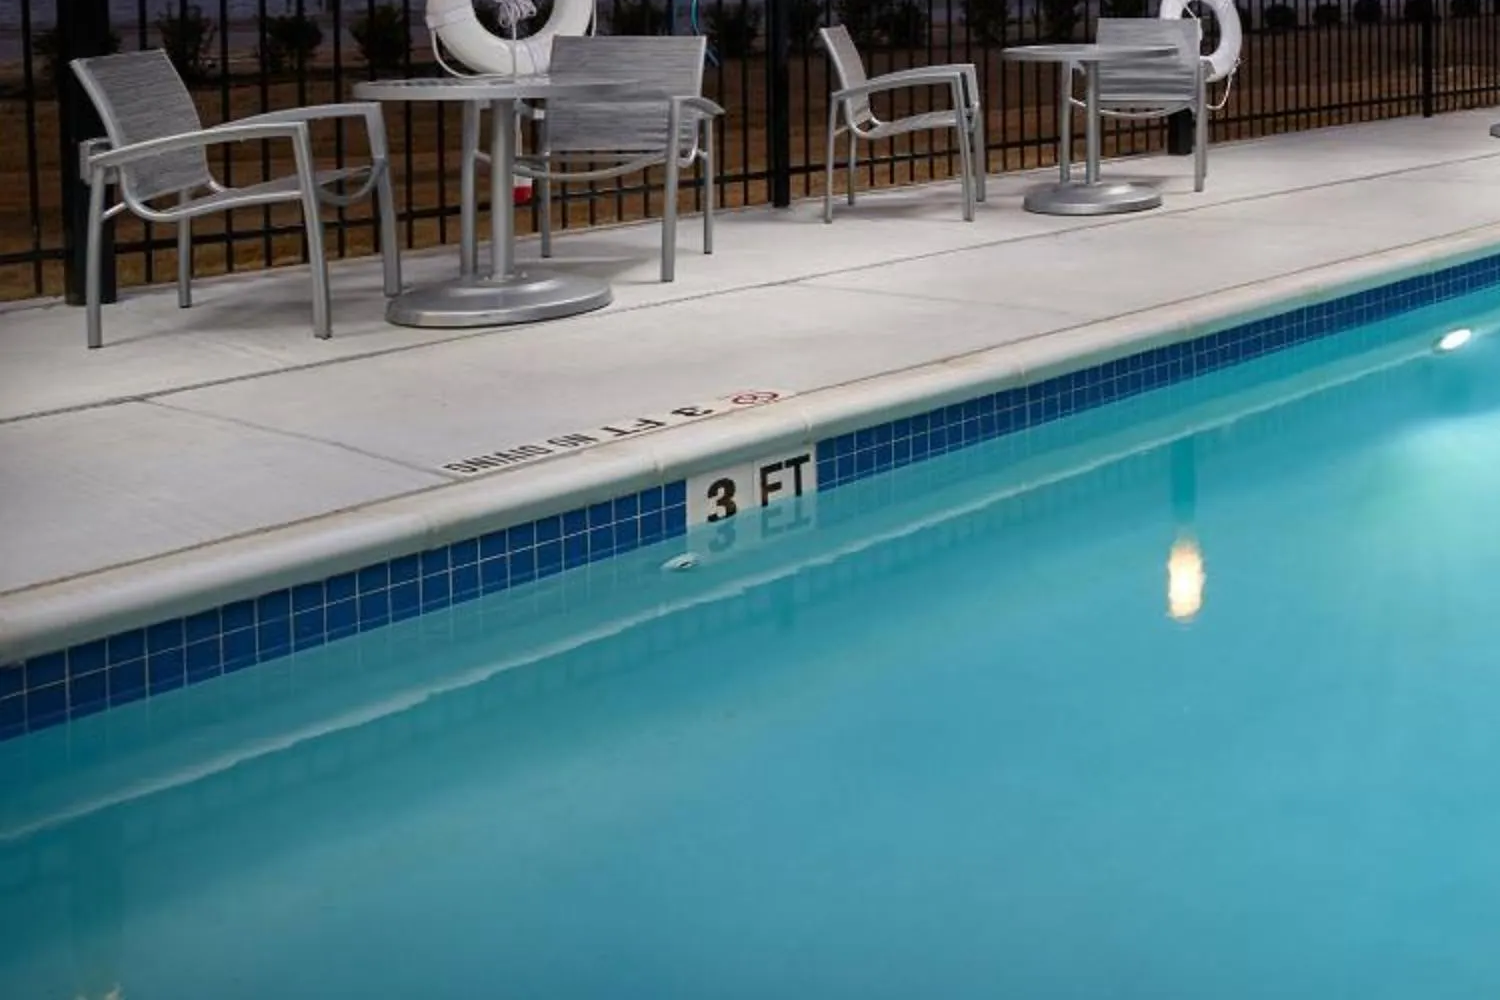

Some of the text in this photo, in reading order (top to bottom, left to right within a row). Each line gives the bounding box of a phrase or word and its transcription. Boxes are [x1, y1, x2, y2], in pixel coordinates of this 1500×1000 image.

[600, 418, 666, 437] FT
[706, 453, 811, 522] 3 FT
